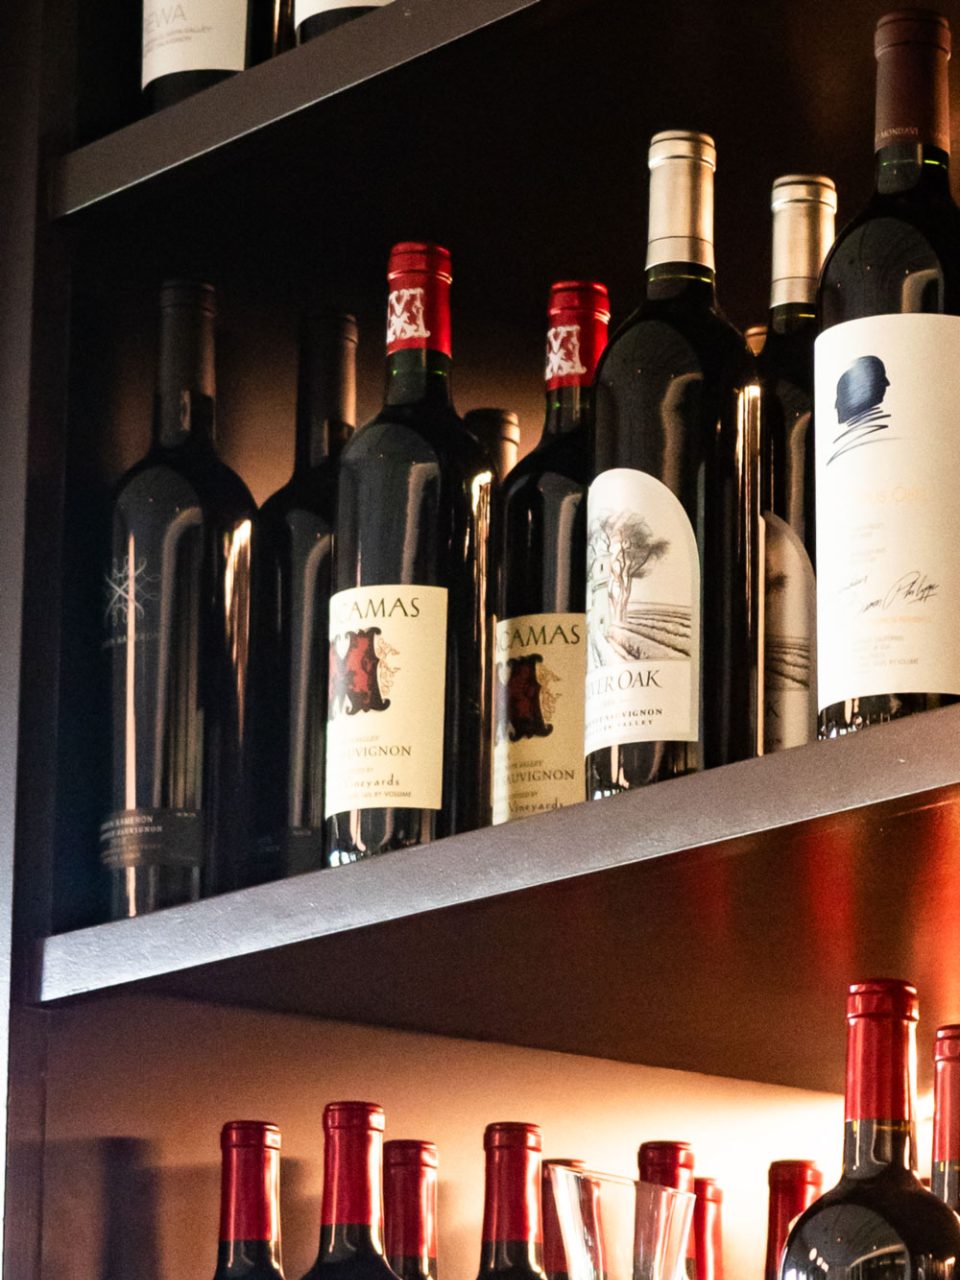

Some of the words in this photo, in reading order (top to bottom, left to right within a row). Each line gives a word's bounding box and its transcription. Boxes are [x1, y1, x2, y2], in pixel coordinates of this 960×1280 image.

[347, 597, 422, 622] AMAS
[617, 669, 664, 691] OAK
[508, 769, 576, 786] UVIGNON
